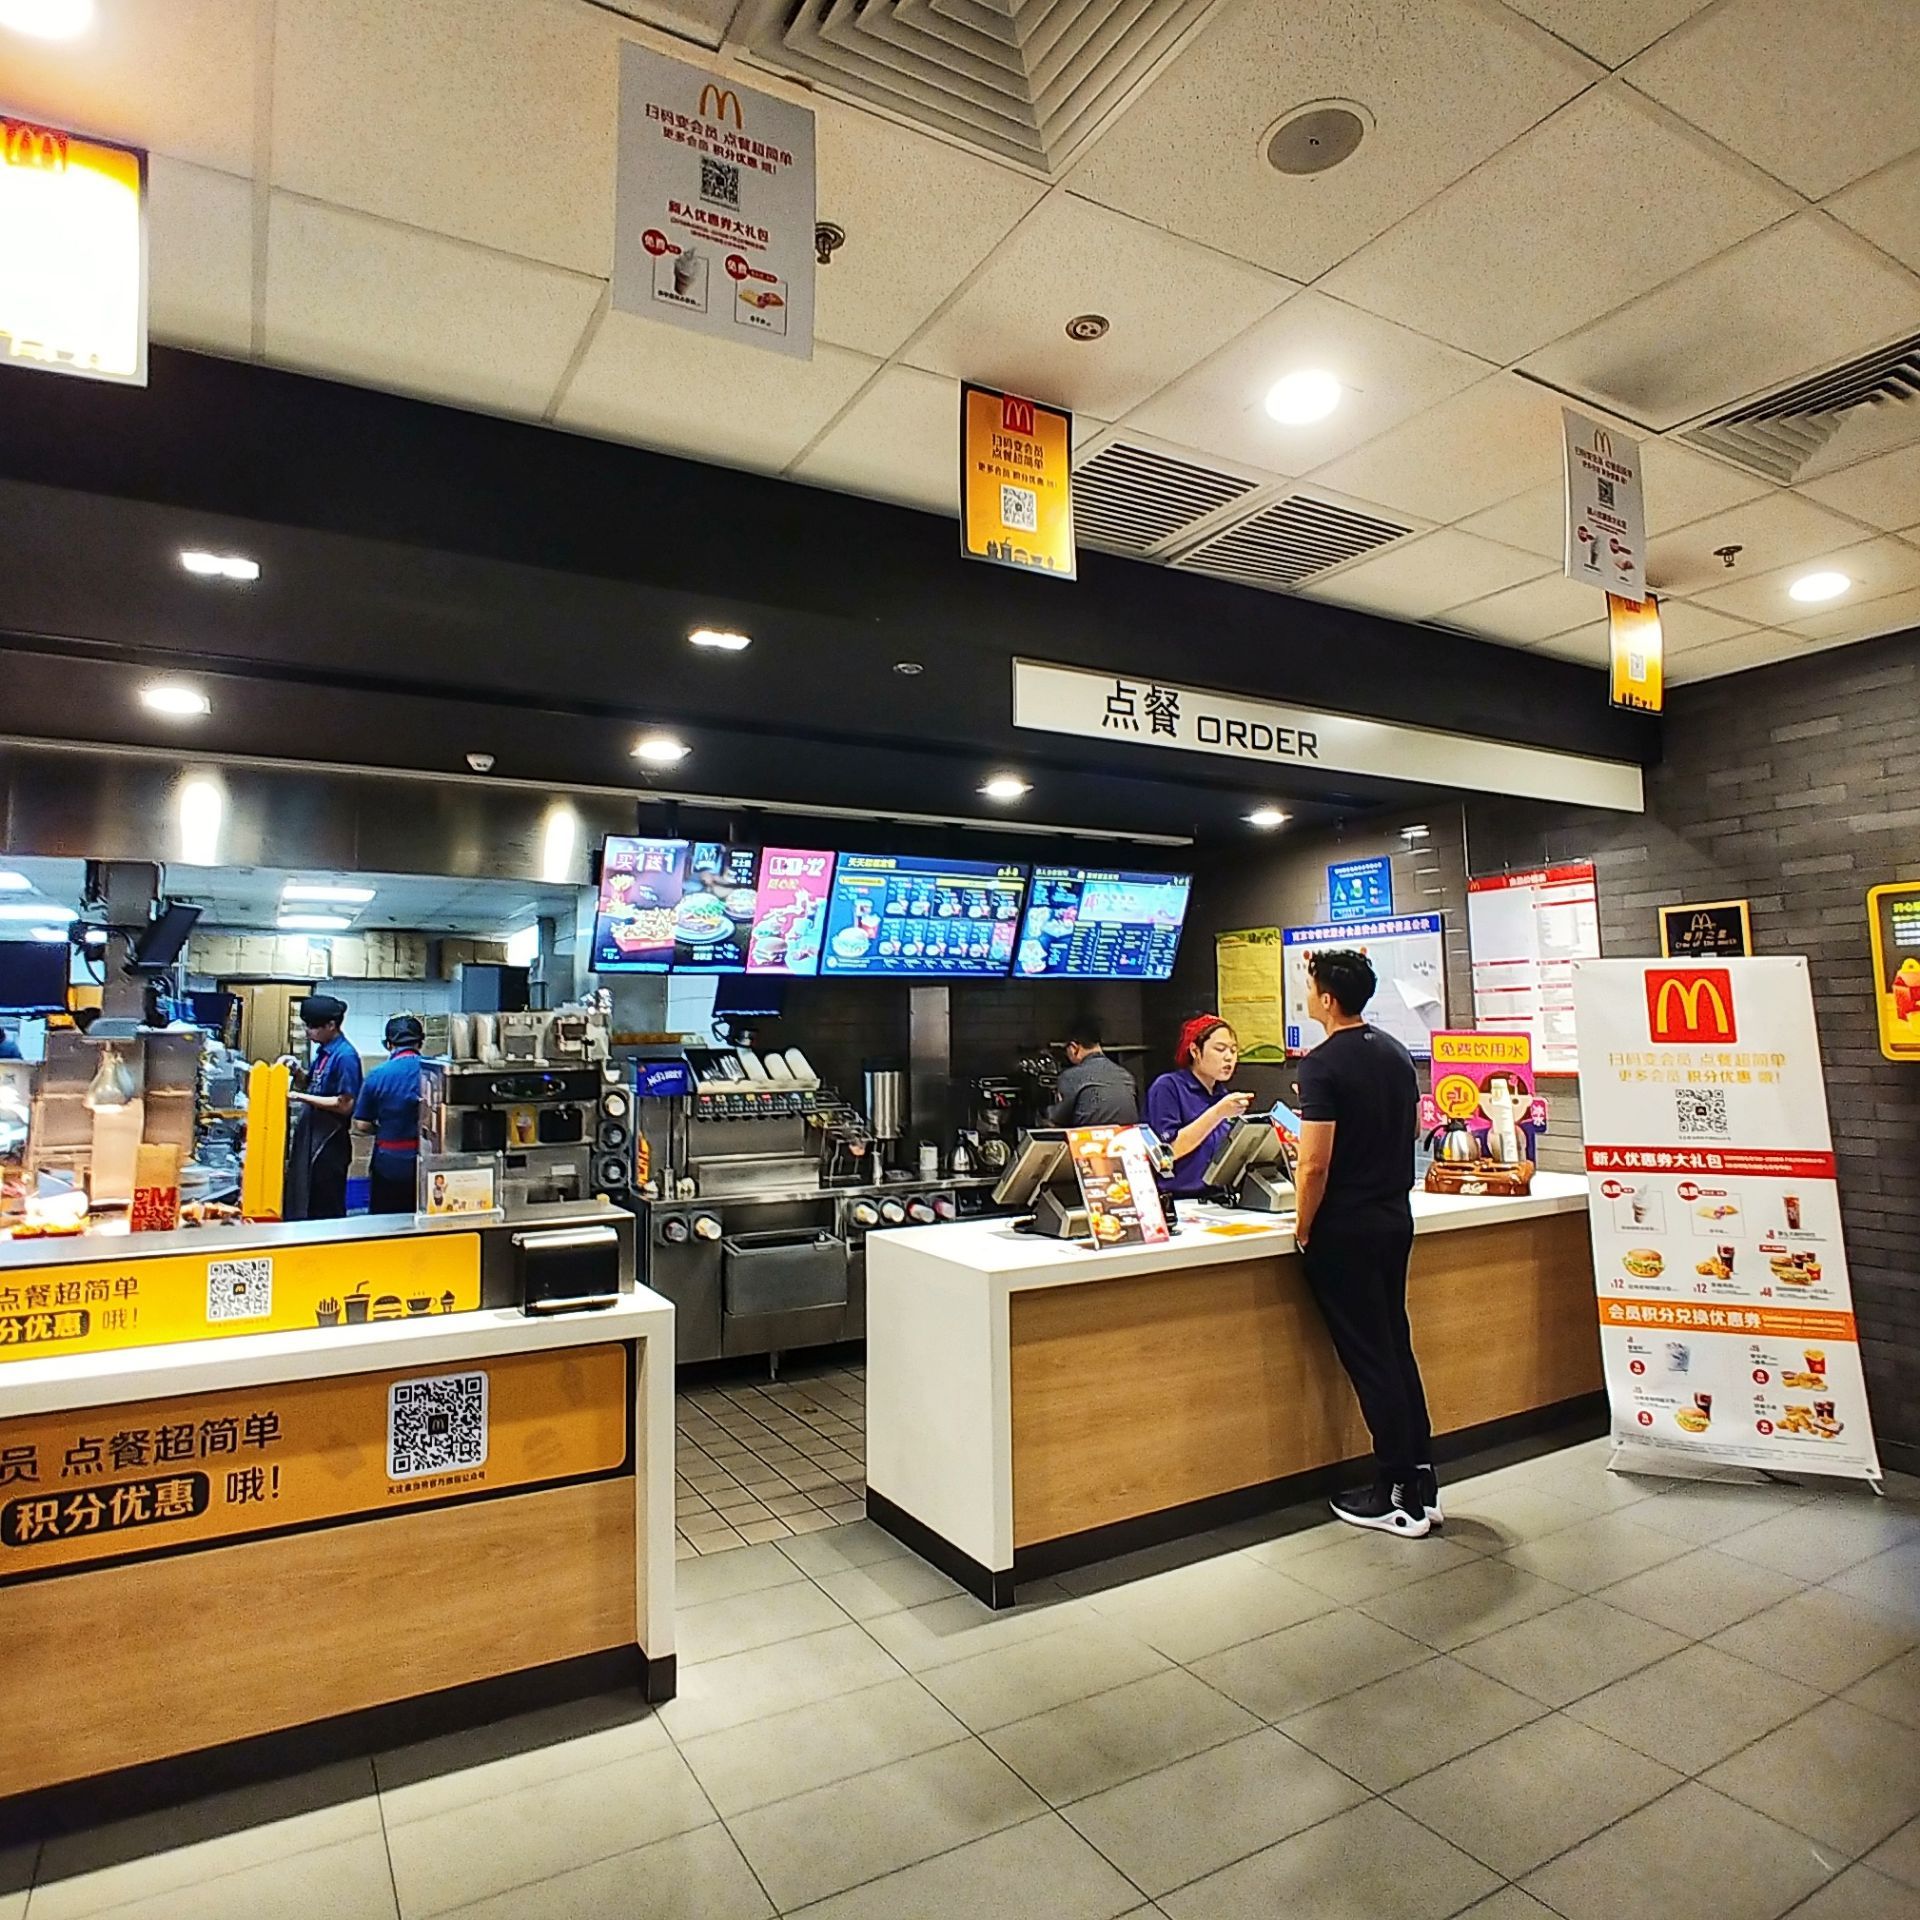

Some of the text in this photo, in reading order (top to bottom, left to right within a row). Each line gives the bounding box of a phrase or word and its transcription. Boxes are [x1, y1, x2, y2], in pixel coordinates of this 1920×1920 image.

[646, 103, 793, 166] 扫码变会员 点餐超简单
[713, 144, 758, 169] 积分优惠
[668, 200, 769, 243] 新人优惠券大礼包
[992, 433, 1044, 458] 扫码变会员
[992, 444, 1044, 470] 点餐超简单
[1102, 680, 1319, 759] 点餐 ORDER
[616, 852, 675, 873] 买1送1
[1440, 1042, 1524, 1058] 免费饮用水
[1609, 1052, 1786, 1068] 扫码变会员 点餐超简单
[1618, 1069, 1682, 1083] 更多会员
[1687, 1069, 1752, 1084] 积分优惠
[1592, 1151, 1723, 1169] 新人优惠券大礼包
[0, 1276, 139, 1312] 点餐超简单
[102, 1307, 138, 1330] 哦!
[1607, 1303, 1761, 1329] 会员积分兑换优惠券
[60, 1410, 282, 1478] 点餐超简单
[15, 1465, 280, 1542] 积分优惠 哦!
